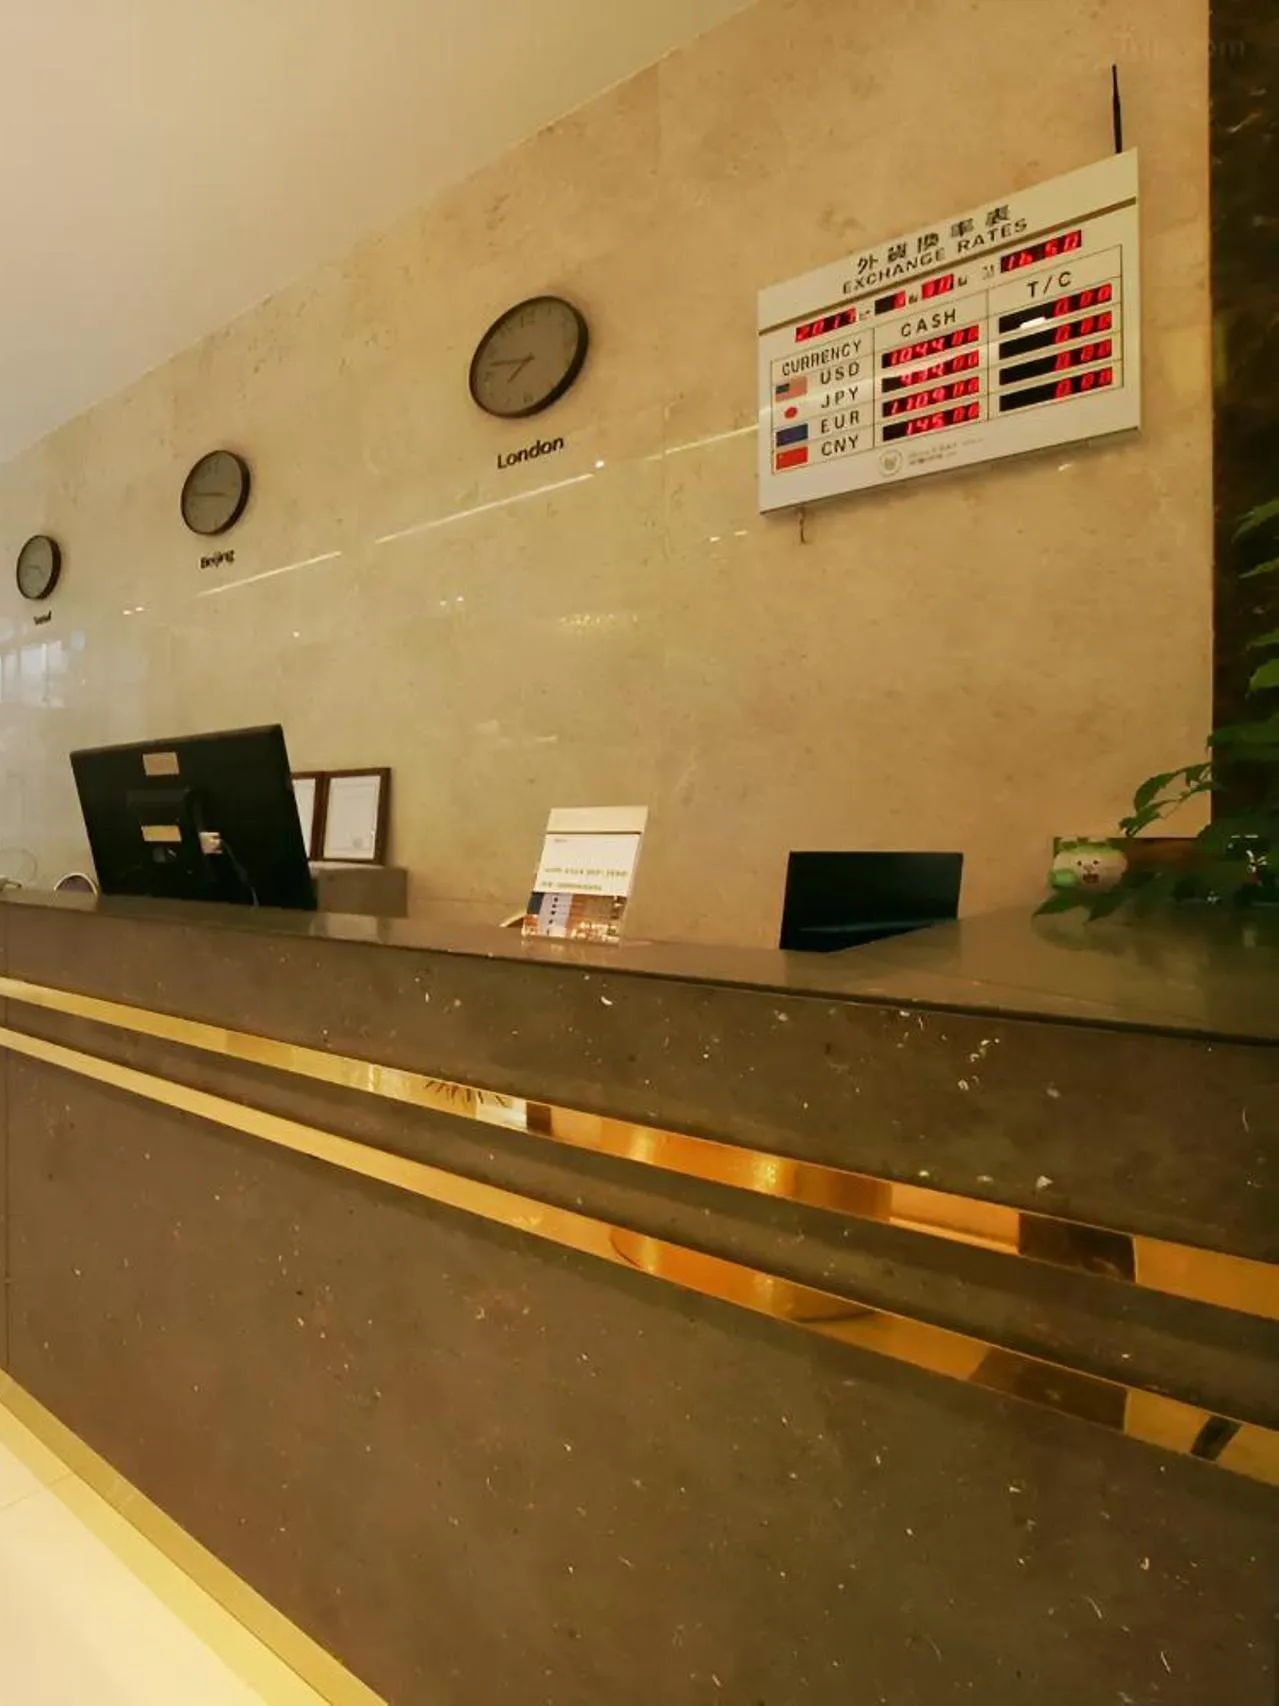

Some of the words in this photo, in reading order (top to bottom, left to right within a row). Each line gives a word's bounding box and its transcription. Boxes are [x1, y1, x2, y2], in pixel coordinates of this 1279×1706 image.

[843, 248, 945, 294] EXCHANGE
[958, 218, 1027, 252] RATES
[1027, 271, 1071, 298] T/C
[901, 308, 956, 337] CASH
[782, 340, 862, 376] CURRENCY
[820, 362, 860, 384] USD
[821, 387, 859, 408] JPY
[821, 410, 860, 433] EUR
[497, 437, 564, 469] London
[821, 435, 859, 456] CNY
